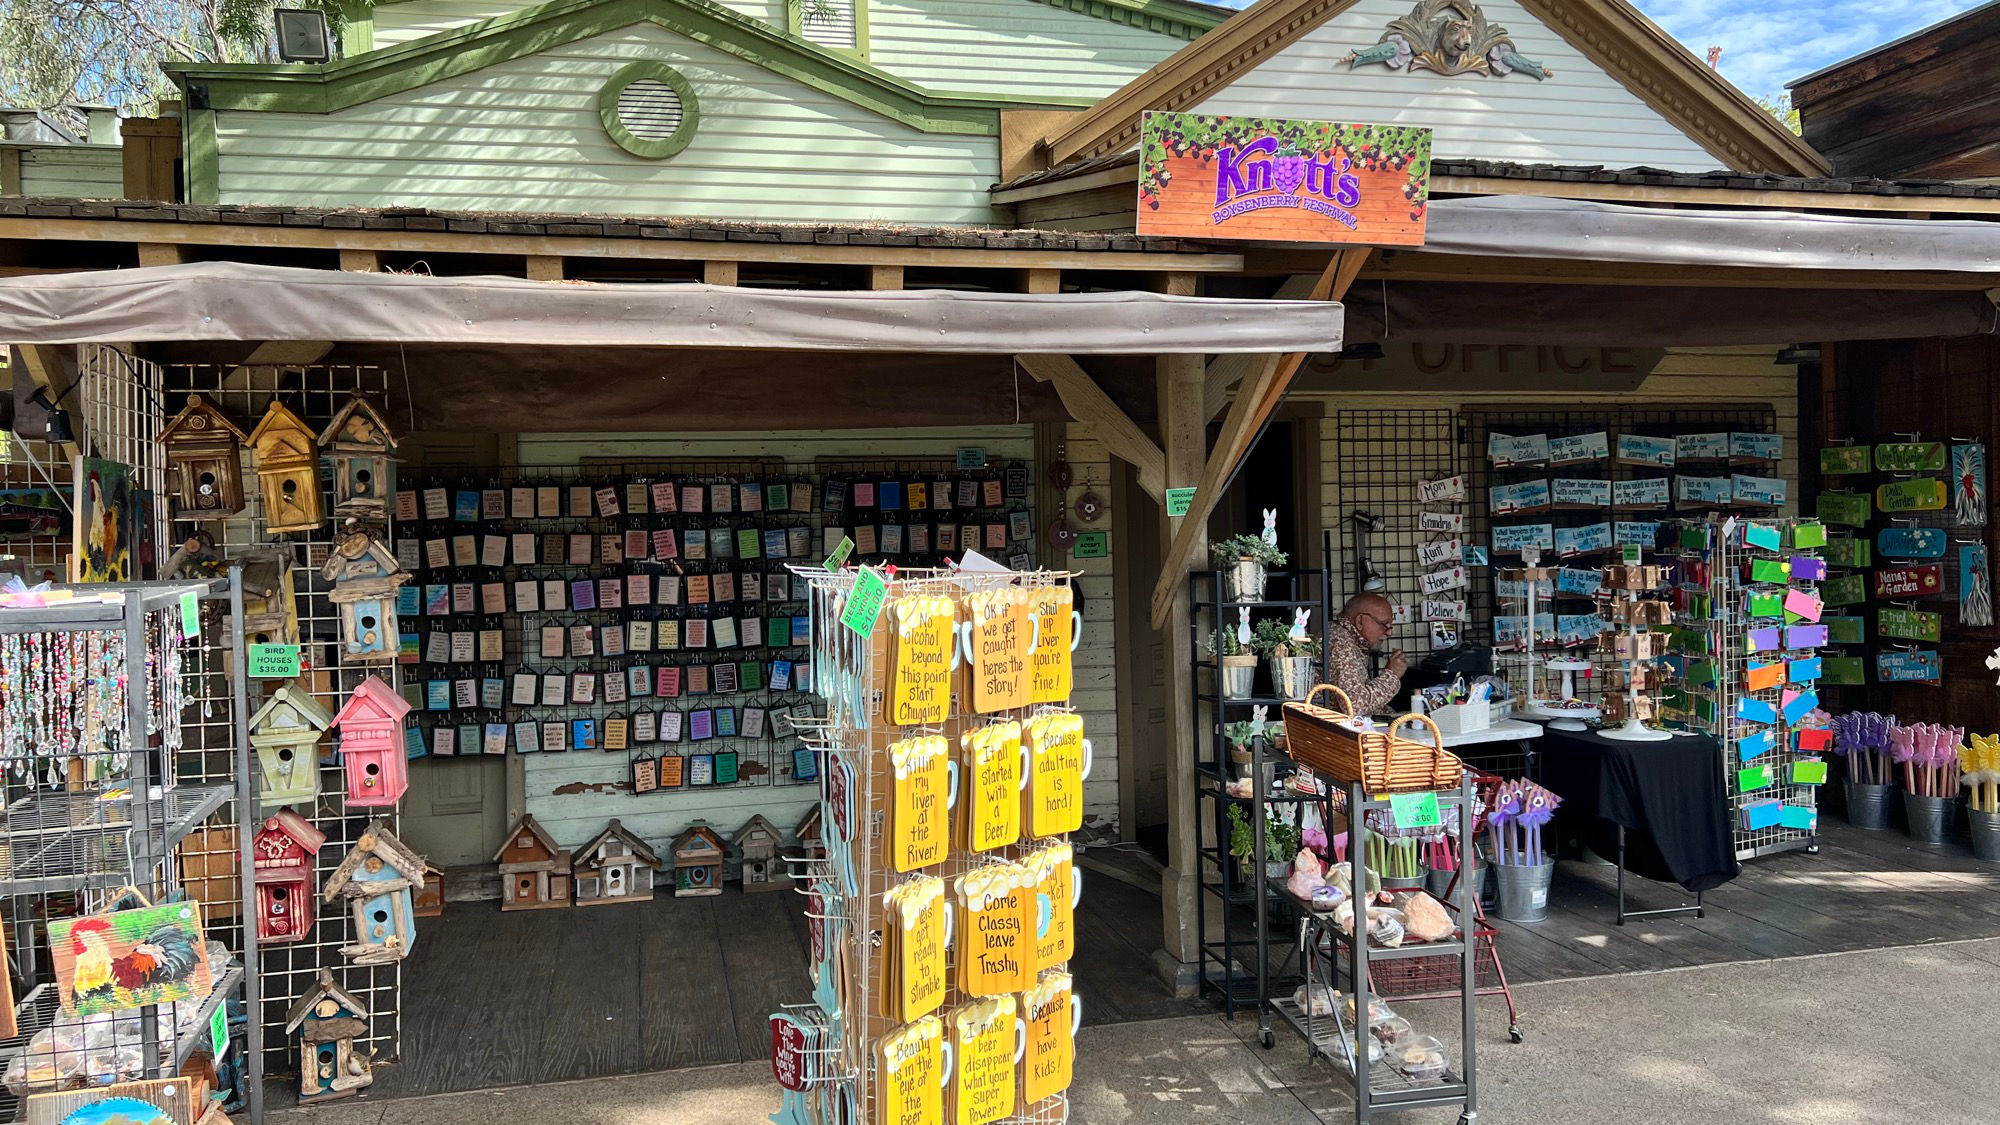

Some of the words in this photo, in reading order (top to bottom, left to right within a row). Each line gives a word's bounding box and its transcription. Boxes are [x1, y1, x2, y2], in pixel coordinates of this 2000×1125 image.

[1215, 136, 1360, 208] Knott's
[1212, 198, 1300, 224] BOYSENBERRY
[1302, 197, 1358, 230] FESTIVAL
[1412, 341, 1636, 375] OFFICE
[1424, 482, 1446, 500] Mom
[1889, 495, 1916, 509] Garden
[1422, 544, 1443, 564] Aunt
[1426, 575, 1449, 591] Hope
[1880, 571, 1907, 583] Nana's
[1886, 580, 1918, 595] Garden
[844, 596, 860, 624] BEER
[857, 571, 869, 597] AND
[857, 589, 872, 616] WINE
[861, 588, 883, 632] $10.00
[984, 604, 998, 620] OK
[1002, 602, 1011, 618] if
[1039, 601, 1058, 616] Shut
[1426, 602, 1455, 618] Believe
[1880, 610, 1887, 622] I
[1889, 611, 1907, 624] tried
[920, 613, 933, 630] No
[983, 624, 997, 637] we
[1002, 619, 1016, 636] get
[1043, 617, 1054, 633] up
[1889, 624, 1896, 636] it
[1899, 624, 1918, 637] died!
[904, 628, 939, 645] alcohol
[983, 636, 1017, 655] caught
[1036, 632, 1060, 649] Liver
[257, 656, 291, 664] HOUSES
[912, 649, 943, 666] beyond
[1033, 651, 1061, 670] you're
[1879, 655, 1905, 667] Garden
[982, 658, 1007, 676] heres
[1008, 658, 1024, 673] the
[901, 667, 922, 684] this
[924, 668, 948, 686] point
[1032, 675, 1060, 692] fine!
[909, 686, 935, 702] start
[986, 675, 1018, 697] story!
[899, 702, 942, 721] Chugging
[1042, 731, 1077, 748] Because
[983, 745, 996, 763] It
[997, 743, 1009, 760] all
[906, 757, 935, 773] Killin
[1039, 757, 1078, 775] adulting
[915, 777, 930, 791] my
[982, 765, 1013, 785] started
[1053, 776, 1063, 791] is
[912, 793, 936, 810] liver
[986, 787, 1008, 803] with
[1046, 794, 1072, 812] hard!
[917, 809, 928, 825] at
[993, 808, 1000, 819] a
[910, 825, 930, 842] the
[984, 821, 1009, 842] Beer!
[907, 843, 938, 864] River!
[1045, 864, 1058, 886] My
[983, 893, 1018, 912] Come
[915, 924, 930, 943] get
[978, 915, 1021, 935] Classy
[984, 932, 1015, 950] leave
[913, 942, 937, 968] ready
[1036, 943, 1055, 959] beer
[919, 964, 930, 978] to
[977, 952, 1019, 978] Trashy
[910, 975, 940, 1004] stumble
[1031, 998, 1065, 1021] Because
[778, 1020, 794, 1040] Love
[965, 1022, 975, 1038] I
[980, 1019, 1005, 1035] make
[1043, 1022, 1051, 1037] I
[782, 1036, 794, 1051] the
[896, 1035, 931, 1061] Beauty
[978, 1039, 998, 1054] beer
[1037, 1037, 1058, 1057] have
[893, 1066, 902, 1083] is
[904, 1064, 914, 1078] in
[916, 1056, 933, 1073] the
[964, 1051, 1012, 1074] disappear
[899, 1077, 915, 1096] eye
[917, 1071, 928, 1088] of
[989, 1070, 1009, 1087] your
[904, 1096, 922, 1112] the
[972, 1088, 1000, 1106] super
[900, 1110, 922, 1125] Beer
